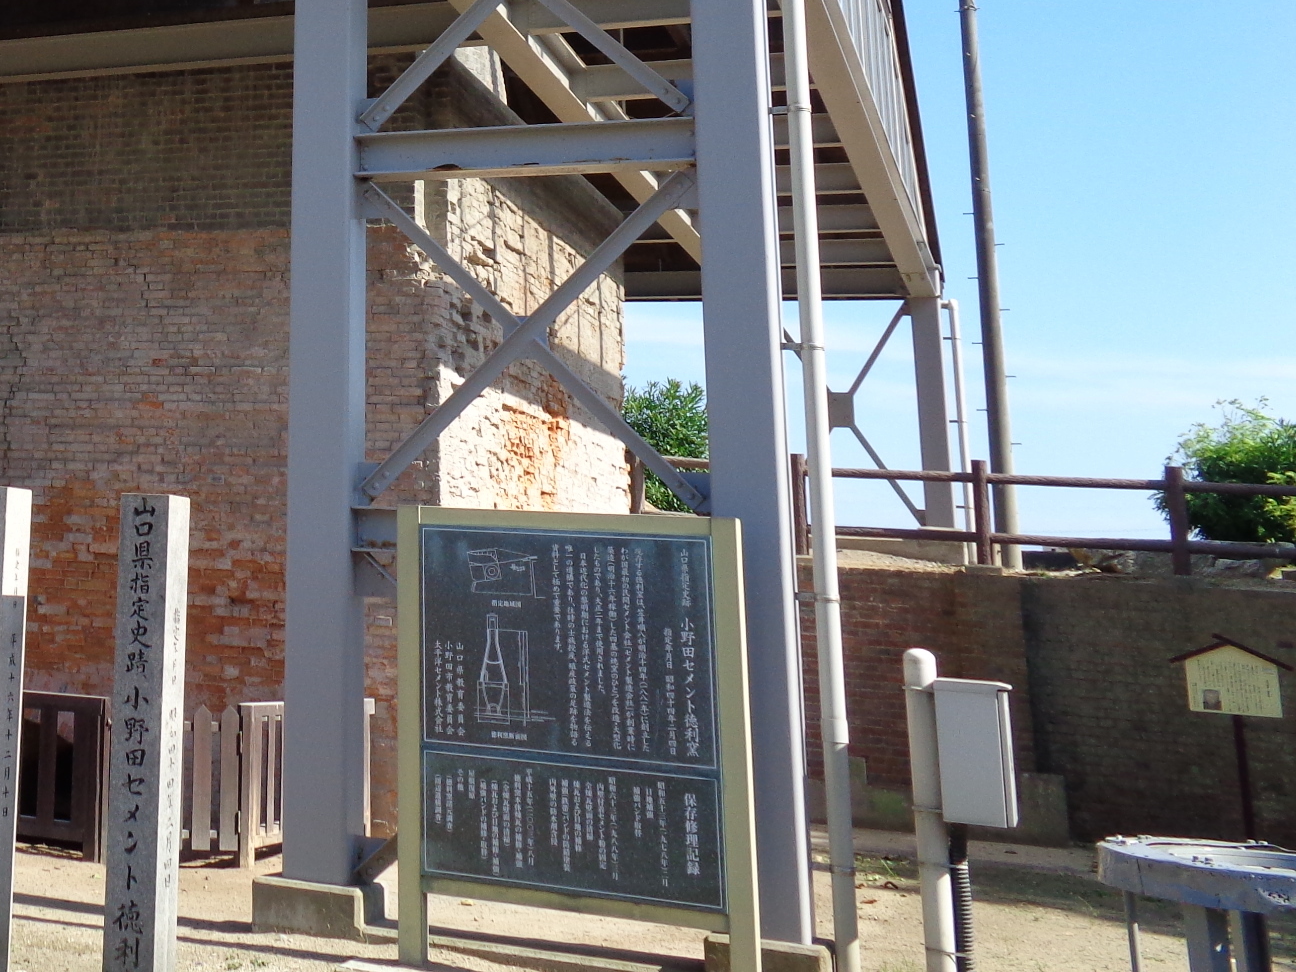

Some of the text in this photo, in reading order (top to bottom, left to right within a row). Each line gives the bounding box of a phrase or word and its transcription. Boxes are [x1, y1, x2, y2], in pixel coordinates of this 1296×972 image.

[434, 639, 443, 733] 太平洋セメント株式会社
[445, 640, 454, 734] 小野田市教育委員会
[455, 641, 465, 736] 山口県教育委員会
[663, 627, 673, 668] 指定年月日
[679, 617, 700, 757] 小野田セメント徳利窯
[2, 633, 18, 817] 平成十六年十二月十日
[112, 496, 156, 972] 山口県指定史蹟 小野田セメント徳利
[683, 792, 700, 875] 保存修理記録
